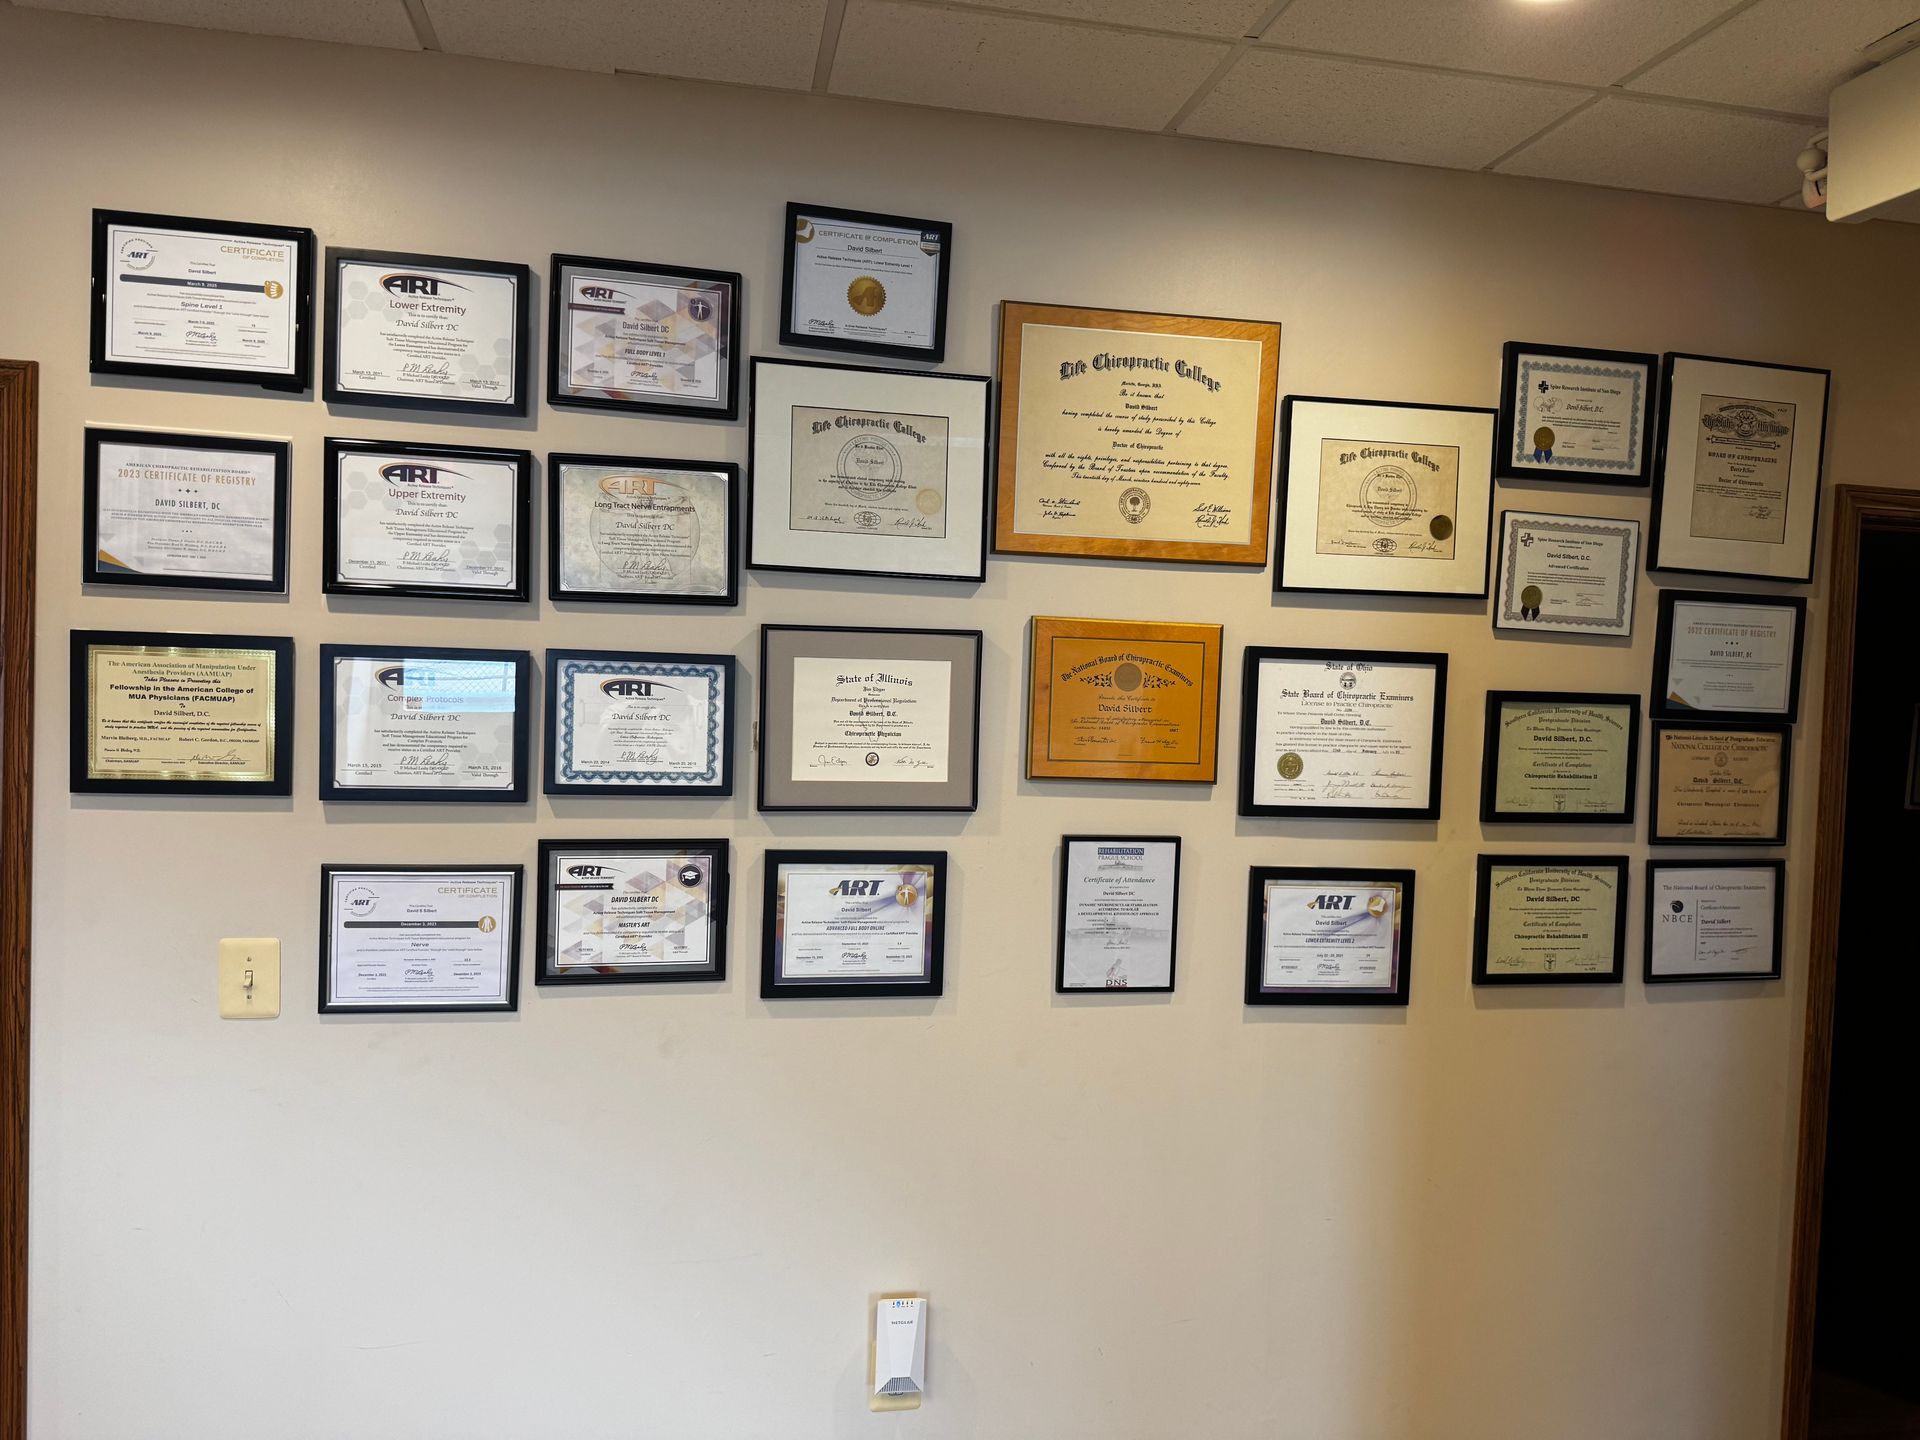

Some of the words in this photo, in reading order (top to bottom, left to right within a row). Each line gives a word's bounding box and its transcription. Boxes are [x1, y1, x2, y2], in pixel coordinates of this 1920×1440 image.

[819, 231, 863, 240] CERTIFICATE
[873, 236, 918, 246] COMPLETION
[220, 246, 284, 258] CERTIFICATE
[383, 275, 440, 296] ART
[390, 300, 419, 310] Lower
[422, 303, 466, 316] Extremity
[396, 320, 419, 328] David
[421, 321, 443, 331] Silbert
[446, 323, 458, 331] DC
[623, 322, 638, 330] David
[640, 323, 659, 332] Silbert
[1060, 359, 1088, 380] Life
[1092, 352, 1170, 372] Chiropractic
[1175, 359, 1222, 393] College
[812, 420, 831, 434] Life
[835, 416, 890, 429] Chiropractic
[893, 420, 926, 443] College
[1137, 442, 1164, 451] Chiropractic
[1340, 452, 1357, 465] Life
[1360, 447, 1408, 460] Chiropractic
[1412, 451, 1440, 472] College
[118, 469, 140, 478] 2023
[144, 470, 197, 482] CERTIFICATE
[201, 474, 212, 483] OF
[216, 475, 256, 486] REGISTRY
[382, 464, 440, 484] ART
[388, 488, 418, 499] Upper
[421, 490, 466, 503] Extremity
[155, 499, 176, 507] DAVID
[179, 500, 209, 510] SILBERT,
[212, 502, 221, 510] DC
[594, 501, 612, 510] Long
[653, 504, 695, 513] Entrapments
[395, 509, 418, 517] David
[420, 509, 443, 518] Silbert
[638, 522, 661, 530] Silbert
[1704, 628, 1738, 636] CERTIFICATE
[1061, 671, 1072, 681] The
[1071, 659, 1097, 676] National
[1099, 655, 1117, 665] Board
[1118, 653, 1125, 661] of
[1126, 654, 1164, 668] Chiropractic
[1164, 664, 1194, 687] Examiners
[1324, 662, 1344, 672] State
[1356, 663, 1373, 673] Ohio
[836, 674, 862, 687] State
[865, 674, 874, 682] of
[876, 673, 913, 686] Illinois
[603, 681, 653, 696] ART
[192, 695, 235, 703] (FACMUAP)
[1280, 689, 1299, 699] State
[1303, 690, 1324, 700] Board
[1327, 691, 1334, 699] of
[1336, 691, 1376, 702] Chiropractic
[1380, 692, 1414, 702] Examiners
[1098, 704, 1120, 712] David
[1123, 705, 1152, 713] Silbert
[829, 880, 884, 896] ART
[1307, 895, 1356, 910] ART
[1662, 914, 1693, 923] NBCE
